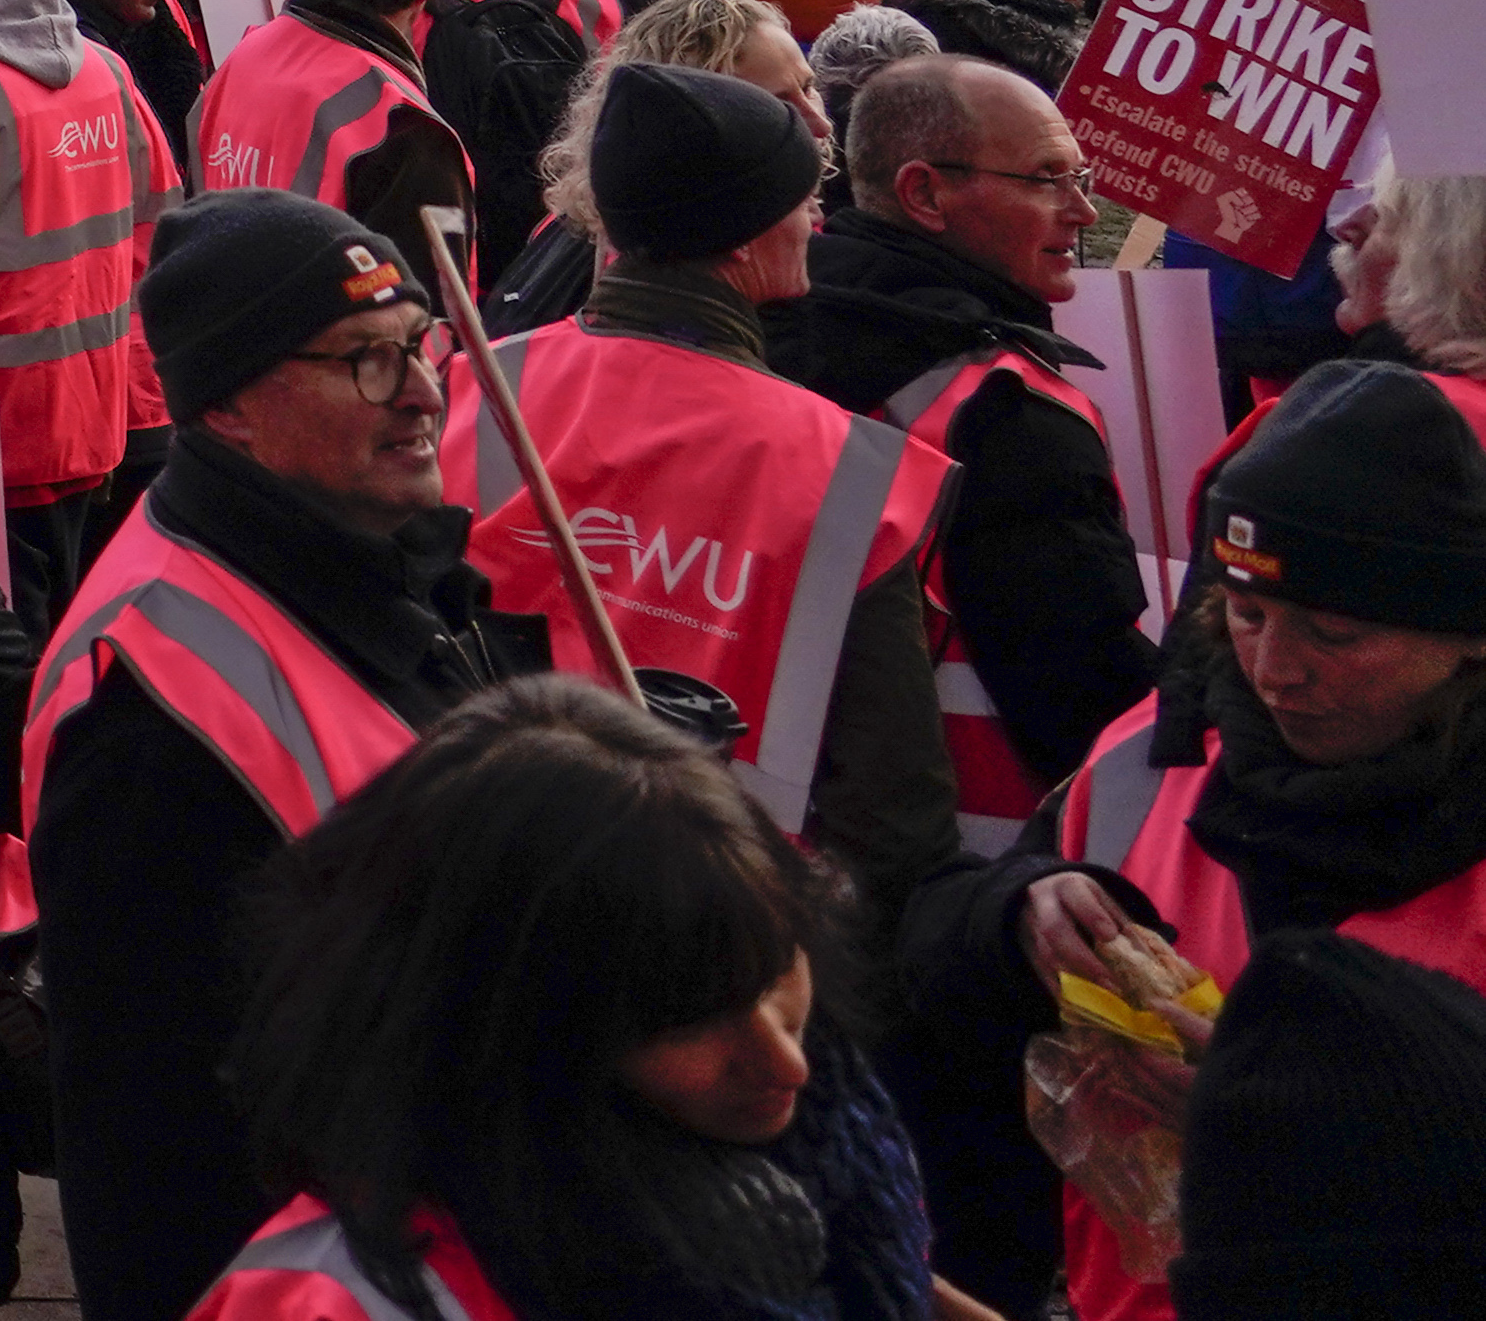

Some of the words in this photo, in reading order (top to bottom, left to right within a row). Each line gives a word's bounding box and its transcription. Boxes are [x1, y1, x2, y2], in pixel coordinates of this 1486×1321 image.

[1103, 6, 1195, 96] TO
[1207, 50, 1354, 170] WIN
[47, 113, 117, 157] CWU
[1073, 118, 1157, 168] Defend
[1160, 155, 1216, 194] CWU
[1090, 85, 1187, 142] Escalate
[1193, 128, 1230, 162] the
[1236, 152, 1315, 202] strikes
[506, 507, 752, 612] CWU
[702, 622, 738, 640] union
